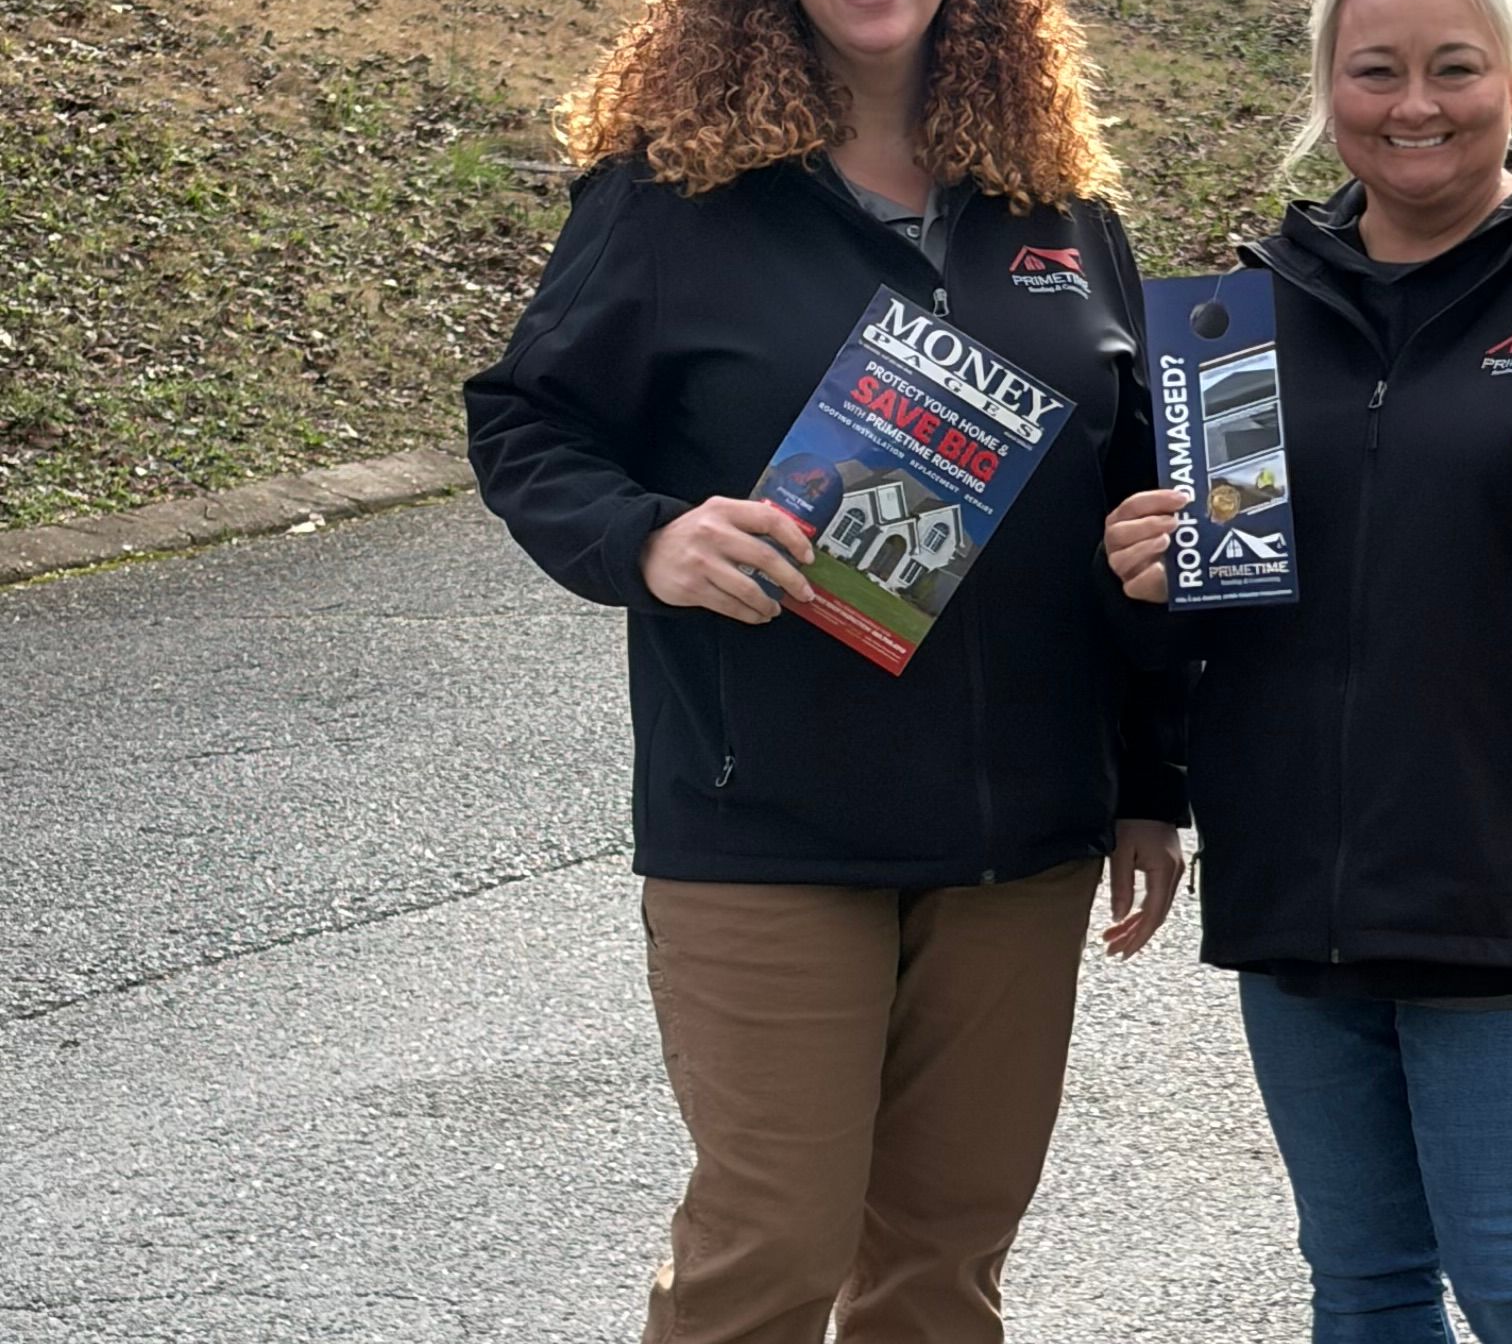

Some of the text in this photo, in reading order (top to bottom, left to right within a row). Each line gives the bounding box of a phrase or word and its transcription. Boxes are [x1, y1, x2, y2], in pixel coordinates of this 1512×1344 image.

[865, 361, 925, 402] PROTECT
[924, 395, 959, 426] YOUR
[958, 418, 1000, 452] HOME
[997, 444, 1009, 458] &
[872, 332, 1032, 438] PAGES
[876, 298, 1064, 426] MONEY
[843, 400, 986, 494] WITH PRIMETIME ROOFING
[850, 375, 1000, 483] SAVE BIG
[1174, 512, 1204, 588] ROOF
[1208, 560, 1291, 579] PRIMETIME
